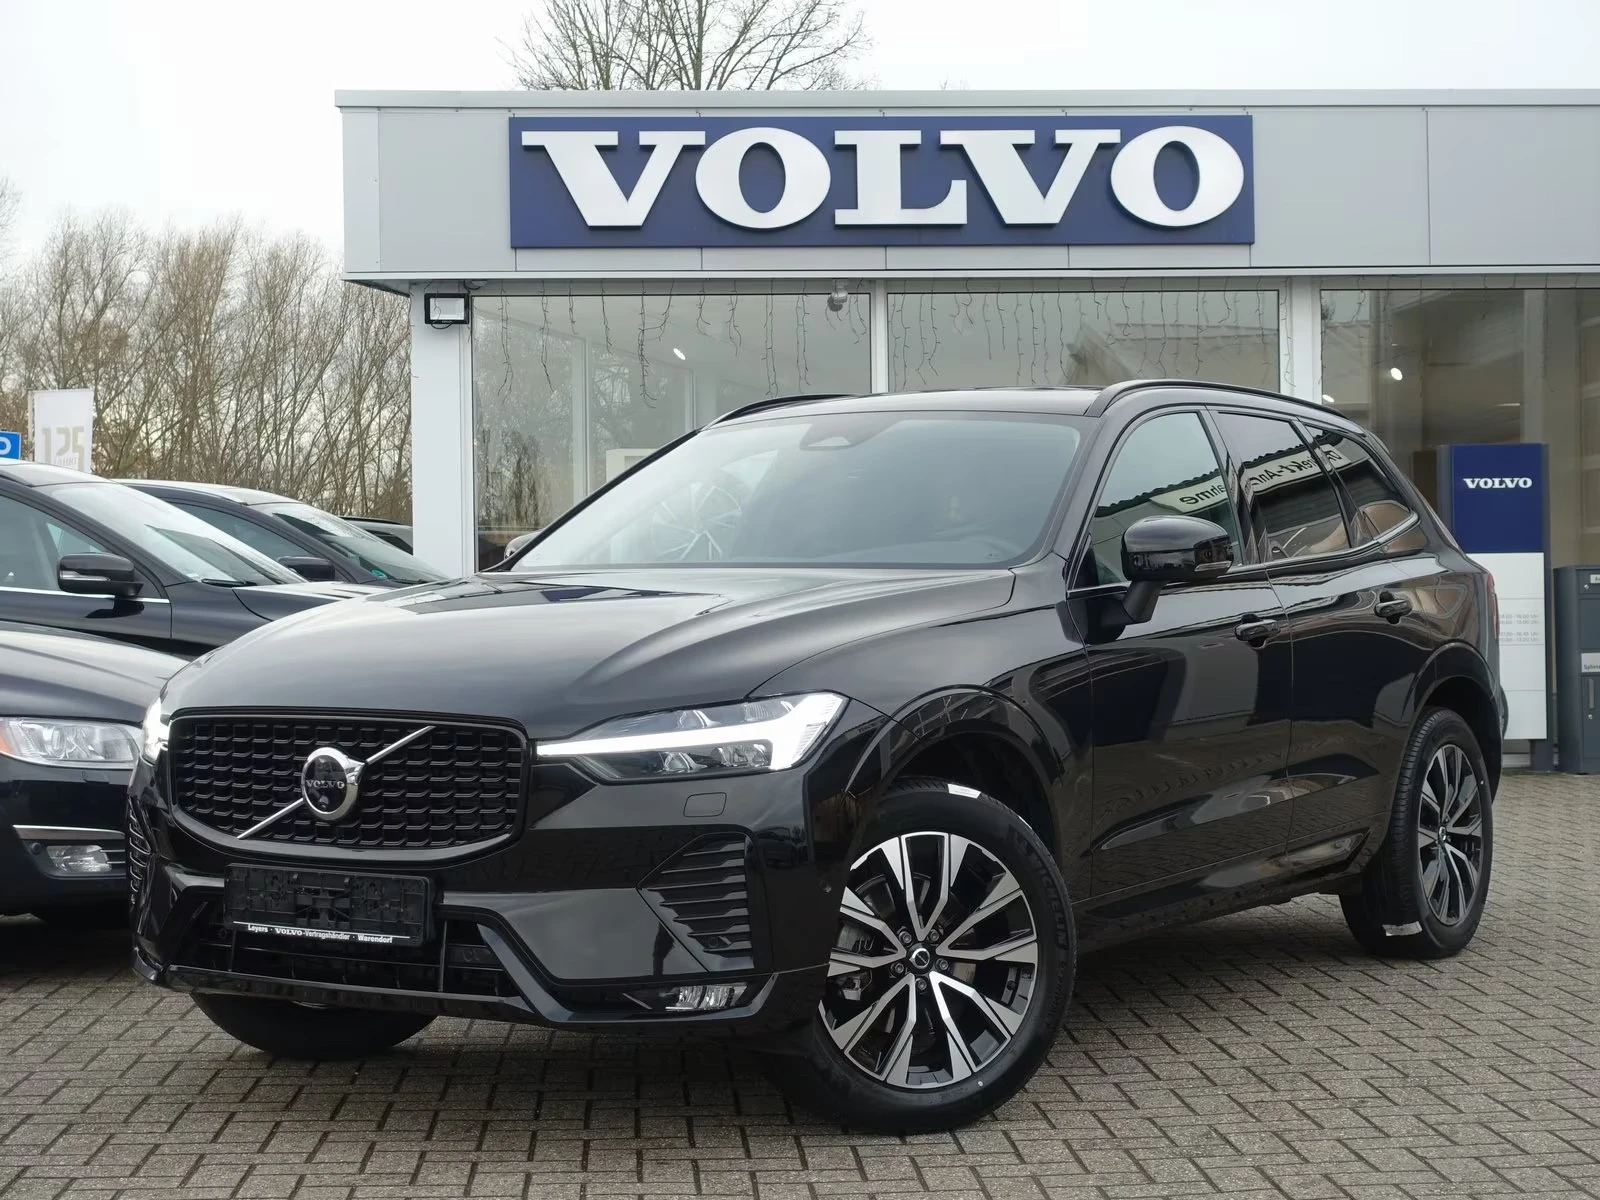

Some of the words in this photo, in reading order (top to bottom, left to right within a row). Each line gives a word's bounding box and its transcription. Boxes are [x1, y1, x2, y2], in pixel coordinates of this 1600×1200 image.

[522, 125, 1245, 229] VOLVO
[1462, 477, 1533, 489] VOLVO
[305, 779, 345, 789] VOLVO
[247, 924, 268, 933] Leyers
[358, 934, 393, 943] Warendorf
